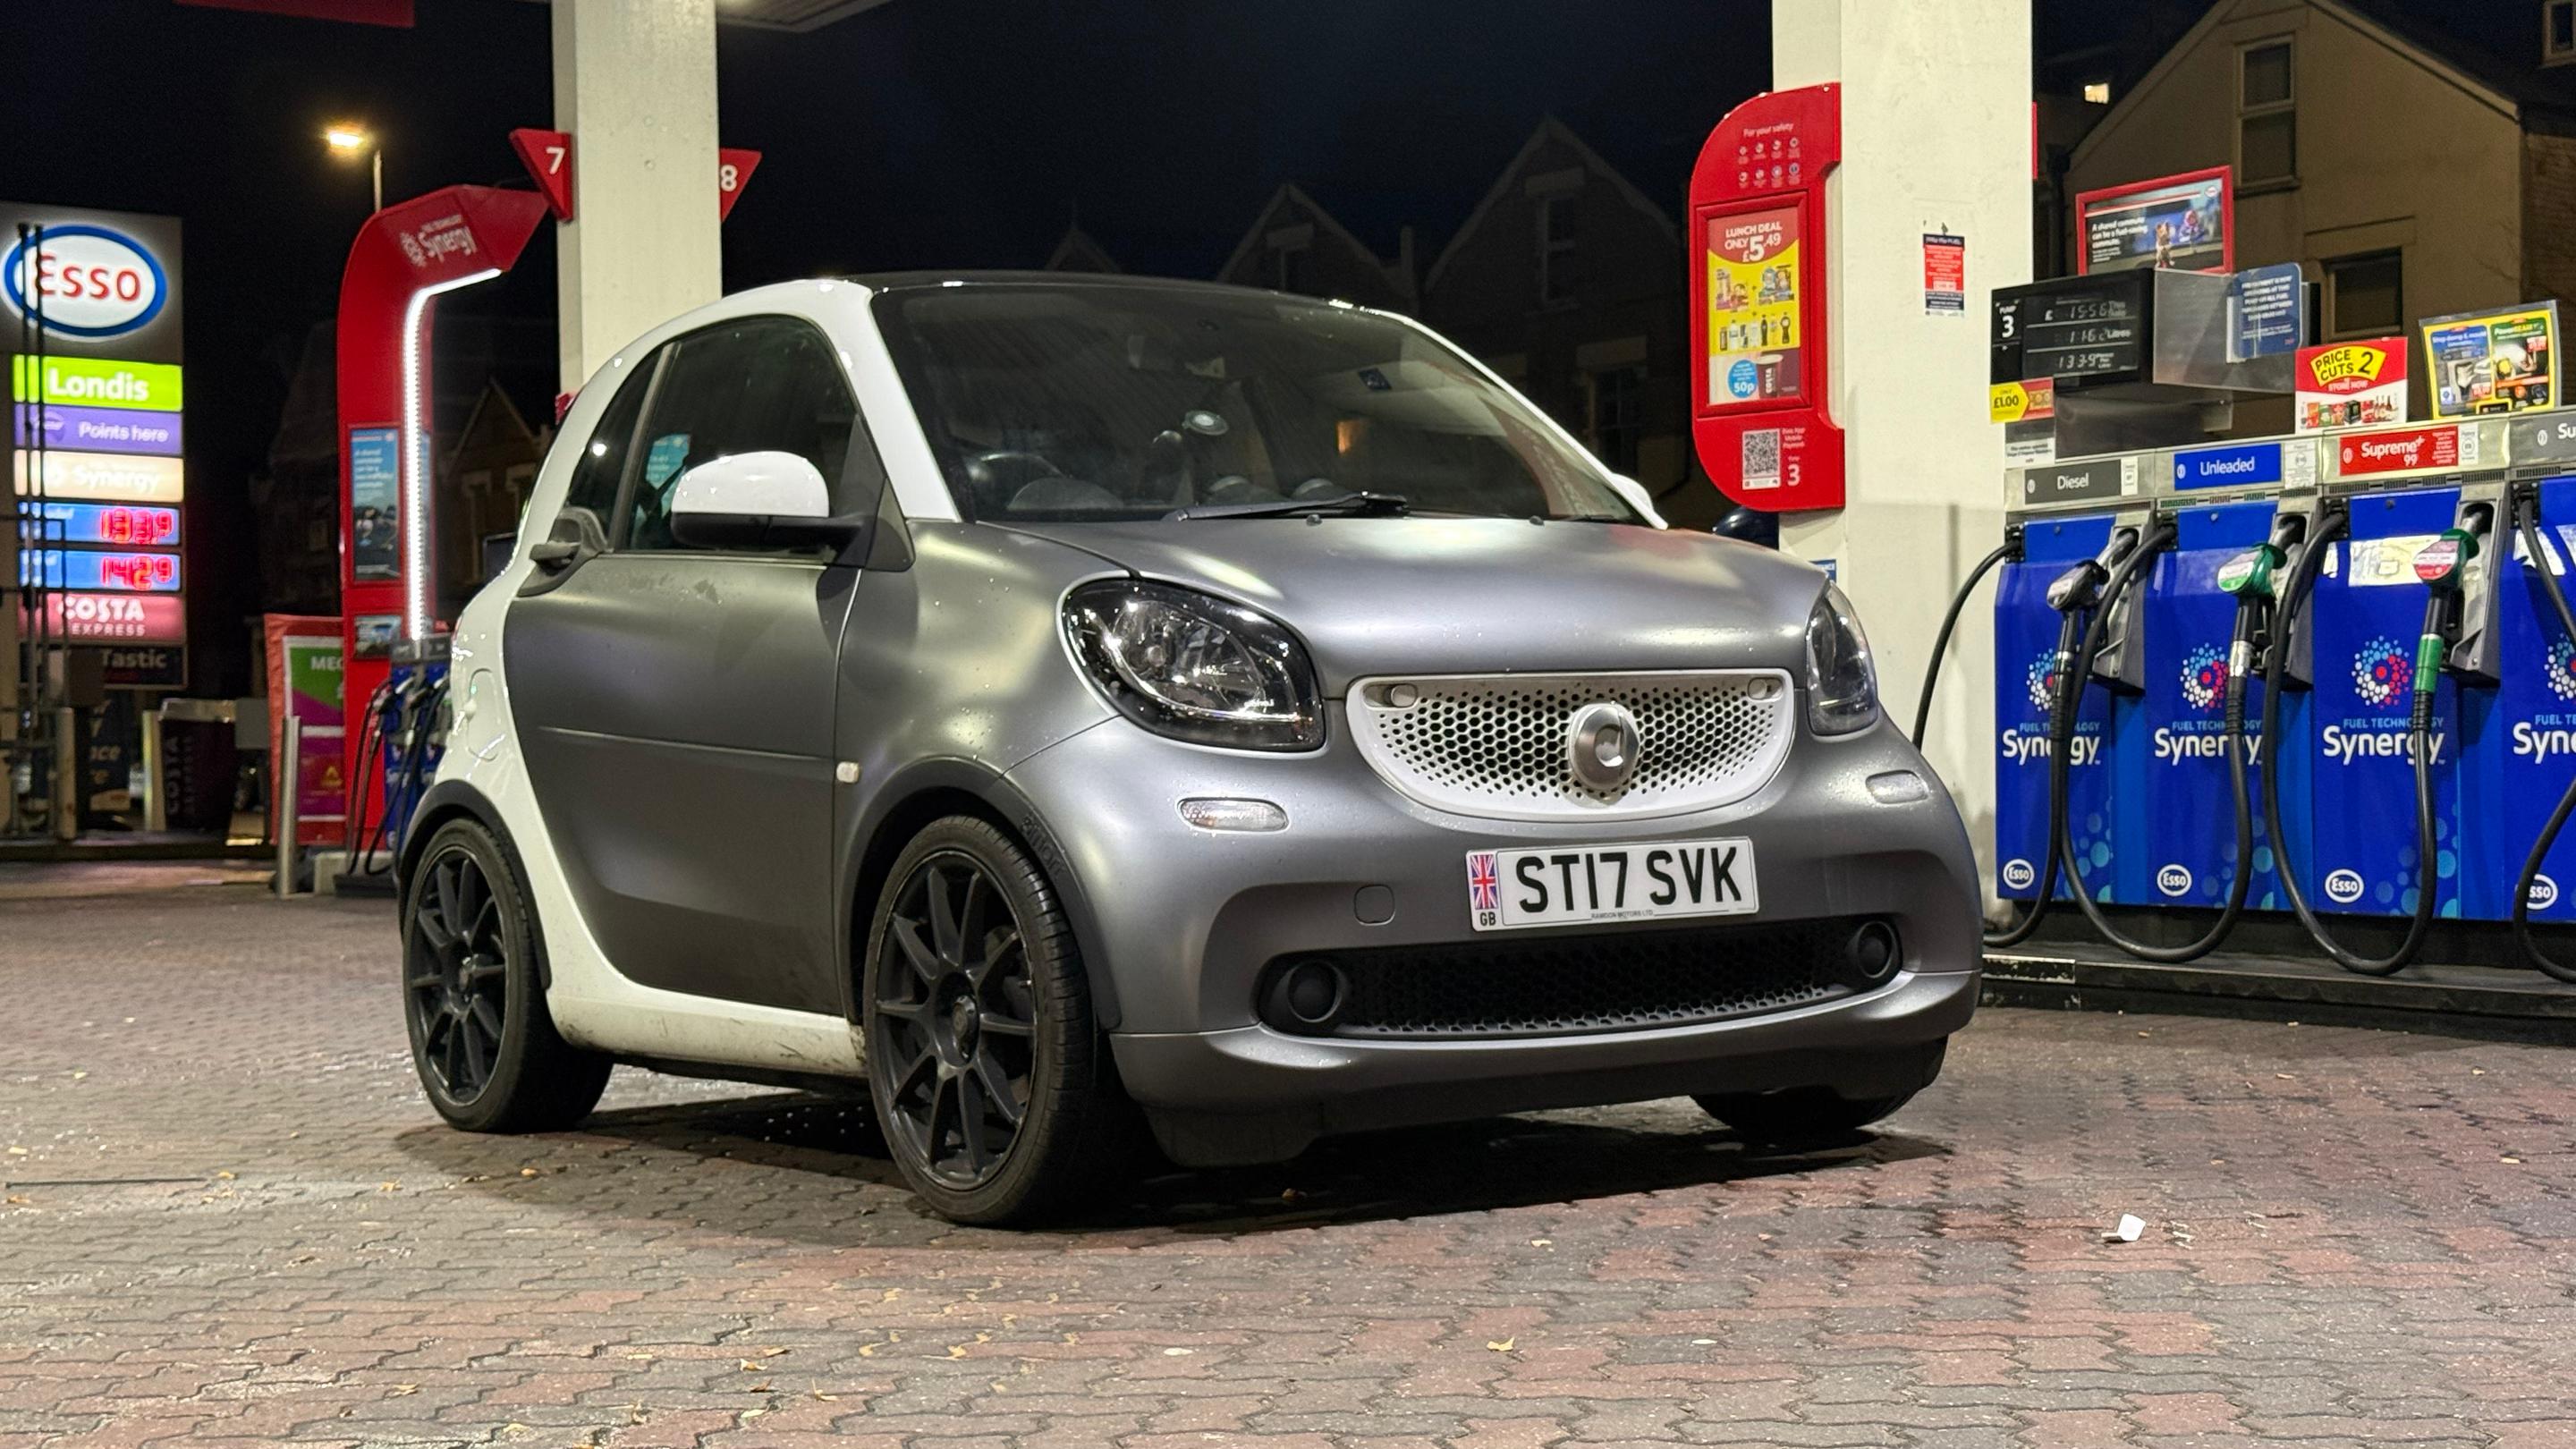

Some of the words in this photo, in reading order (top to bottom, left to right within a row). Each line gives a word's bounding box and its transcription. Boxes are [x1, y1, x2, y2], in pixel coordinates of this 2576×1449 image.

[546, 147, 565, 174] 7
[720, 165, 738, 191] 8
[1725, 225, 1757, 238] LUNCH
[1758, 221, 1783, 233] DEAL
[1724, 238, 1749, 250] ONLY
[2002, 315, 2014, 338] 3
[2315, 349, 2351, 371] PRICE
[2358, 351, 2374, 374] 2
[2320, 362, 2354, 381] CUTS
[48, 367, 149, 402] Londis
[1733, 381, 1755, 394] 50p
[1994, 395, 2019, 408] £1.00
[79, 420, 130, 441] Points
[131, 423, 169, 442] here
[2200, 456, 2255, 476] Unleaded
[2403, 454, 2418, 466] 99
[1787, 463, 1801, 487] 3
[2057, 472, 2089, 490] Diesel
[57, 597, 145, 623] COSTA
[72, 623, 145, 637] EXPRESS
[101, 648, 167, 668] Tastic
[2020, 723, 2039, 732] FUEL
[2172, 721, 2194, 731] FUEL
[2343, 718, 2368, 728] FUEL
[2535, 715, 2562, 725] FUEL
[2003, 729, 2100, 766] Syngy
[2155, 727, 2262, 766] Synery
[1646, 847, 1741, 906] SVK
[2529, 886, 2551, 899] sso
[1479, 911, 1496, 926] GB
